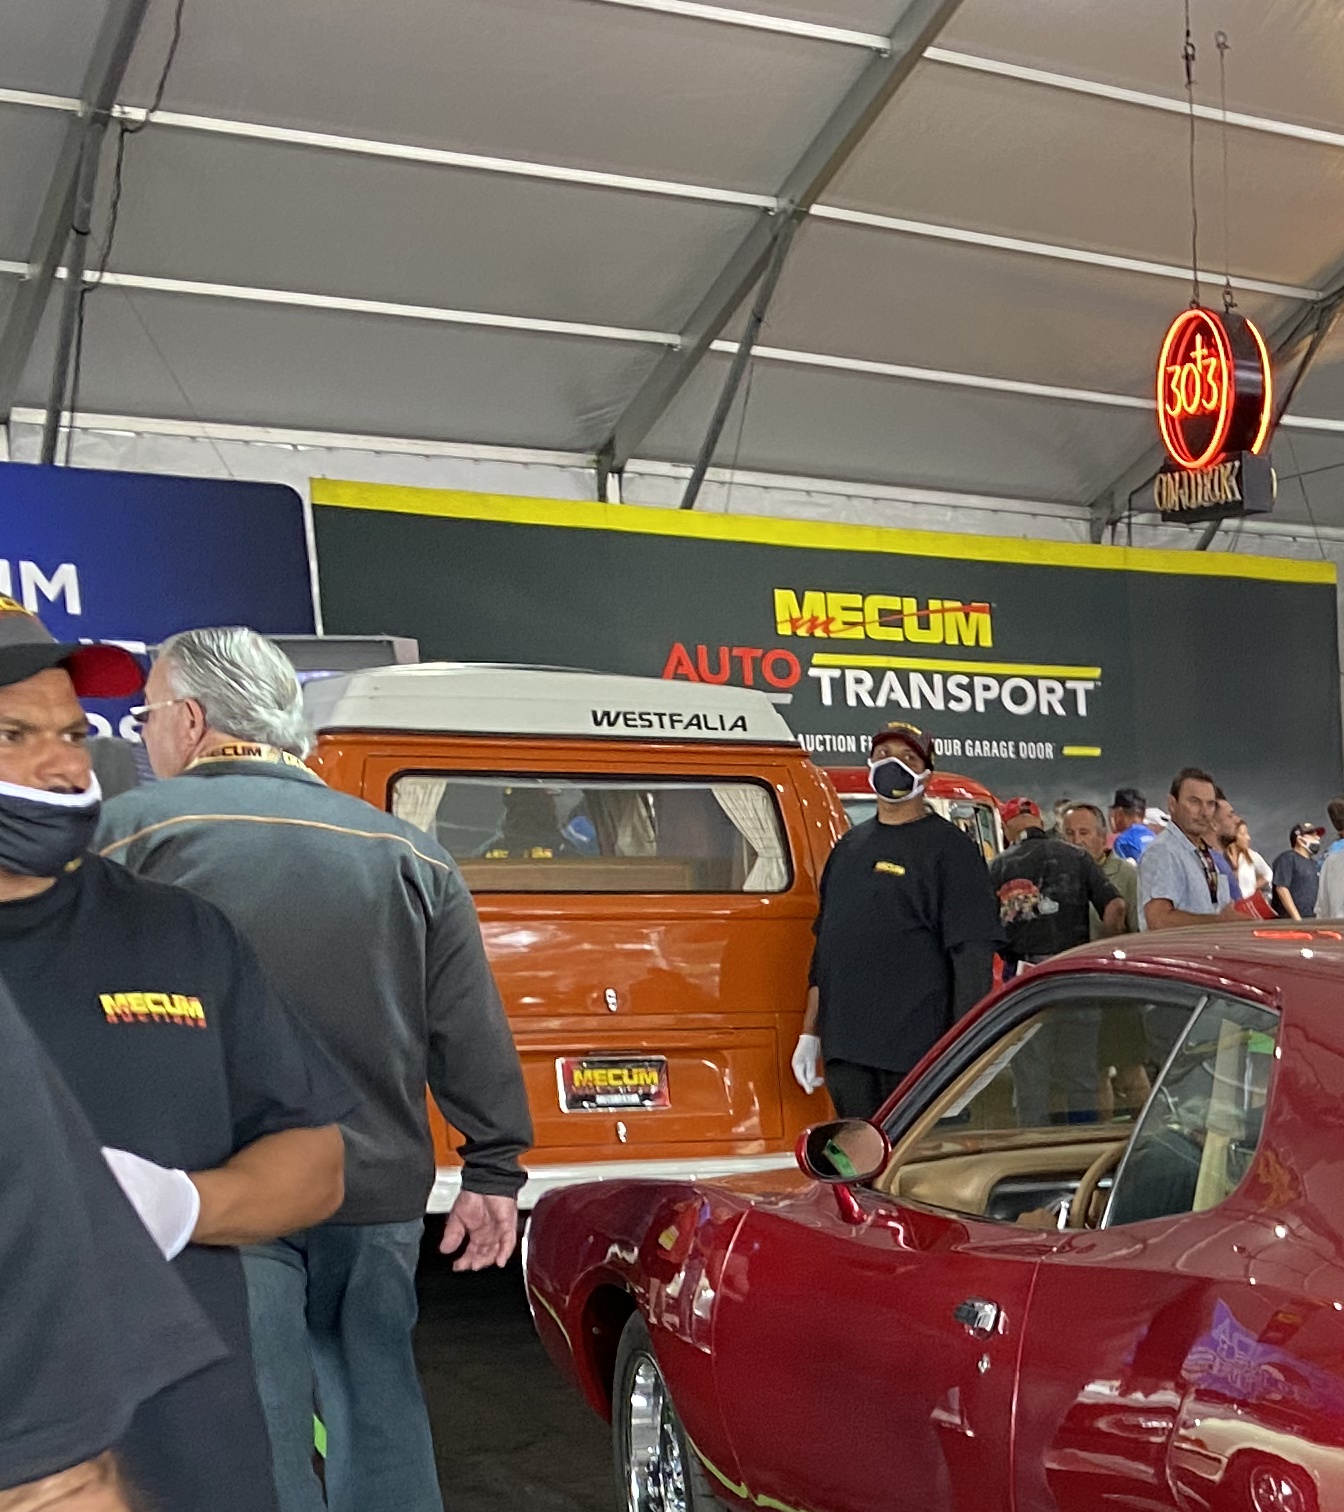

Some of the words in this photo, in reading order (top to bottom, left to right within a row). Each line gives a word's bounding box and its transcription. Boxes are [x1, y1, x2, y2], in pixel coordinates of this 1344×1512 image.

[774, 588, 995, 648] MECUM
[662, 642, 801, 689] AUTO
[807, 667, 1098, 717] TRANSPORT
[591, 709, 748, 733] WESTFALIA
[933, 738, 962, 756] OUR
[964, 739, 1016, 758] GARAGE
[1018, 742, 1054, 759] DOOR
[99, 991, 206, 1020] MECUM
[572, 1067, 659, 1087] MECUM
